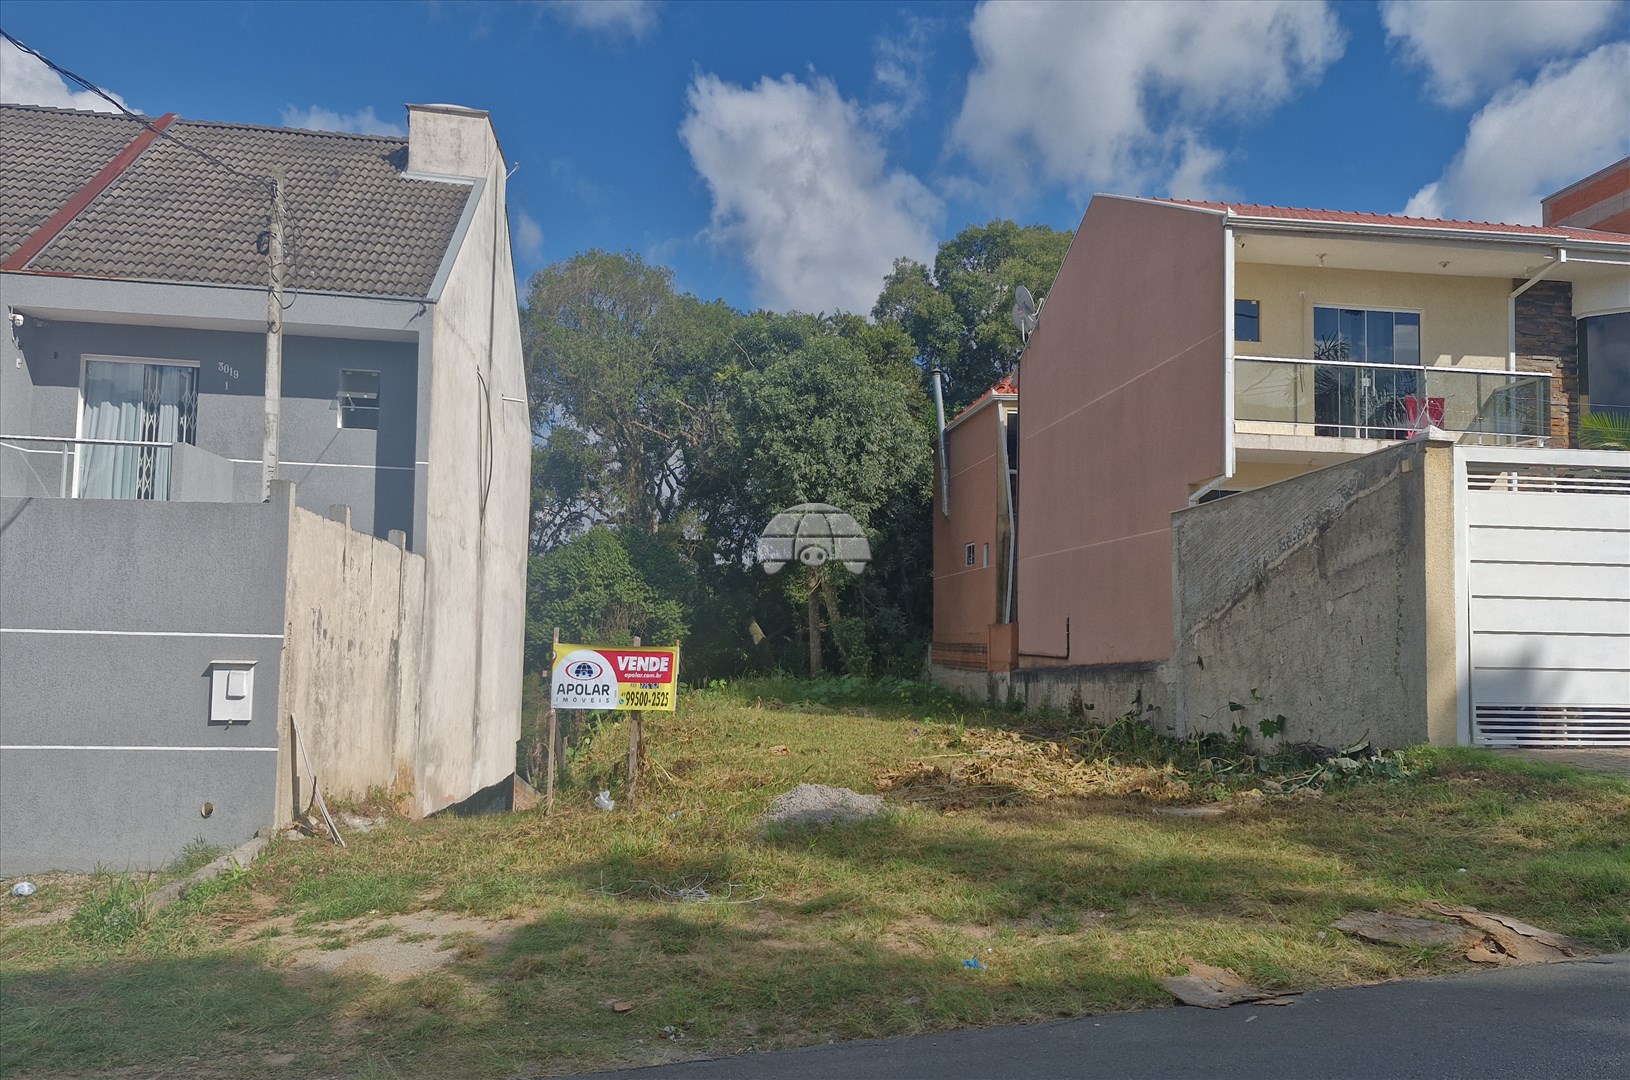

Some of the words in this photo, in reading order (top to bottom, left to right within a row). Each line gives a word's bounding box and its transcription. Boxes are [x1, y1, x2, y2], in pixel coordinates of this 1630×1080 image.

[218, 361, 239, 379] 3019
[617, 656, 669, 672] VENDE
[556, 683, 610, 695] APOLAR
[625, 691, 669, 707] 99500-2525
